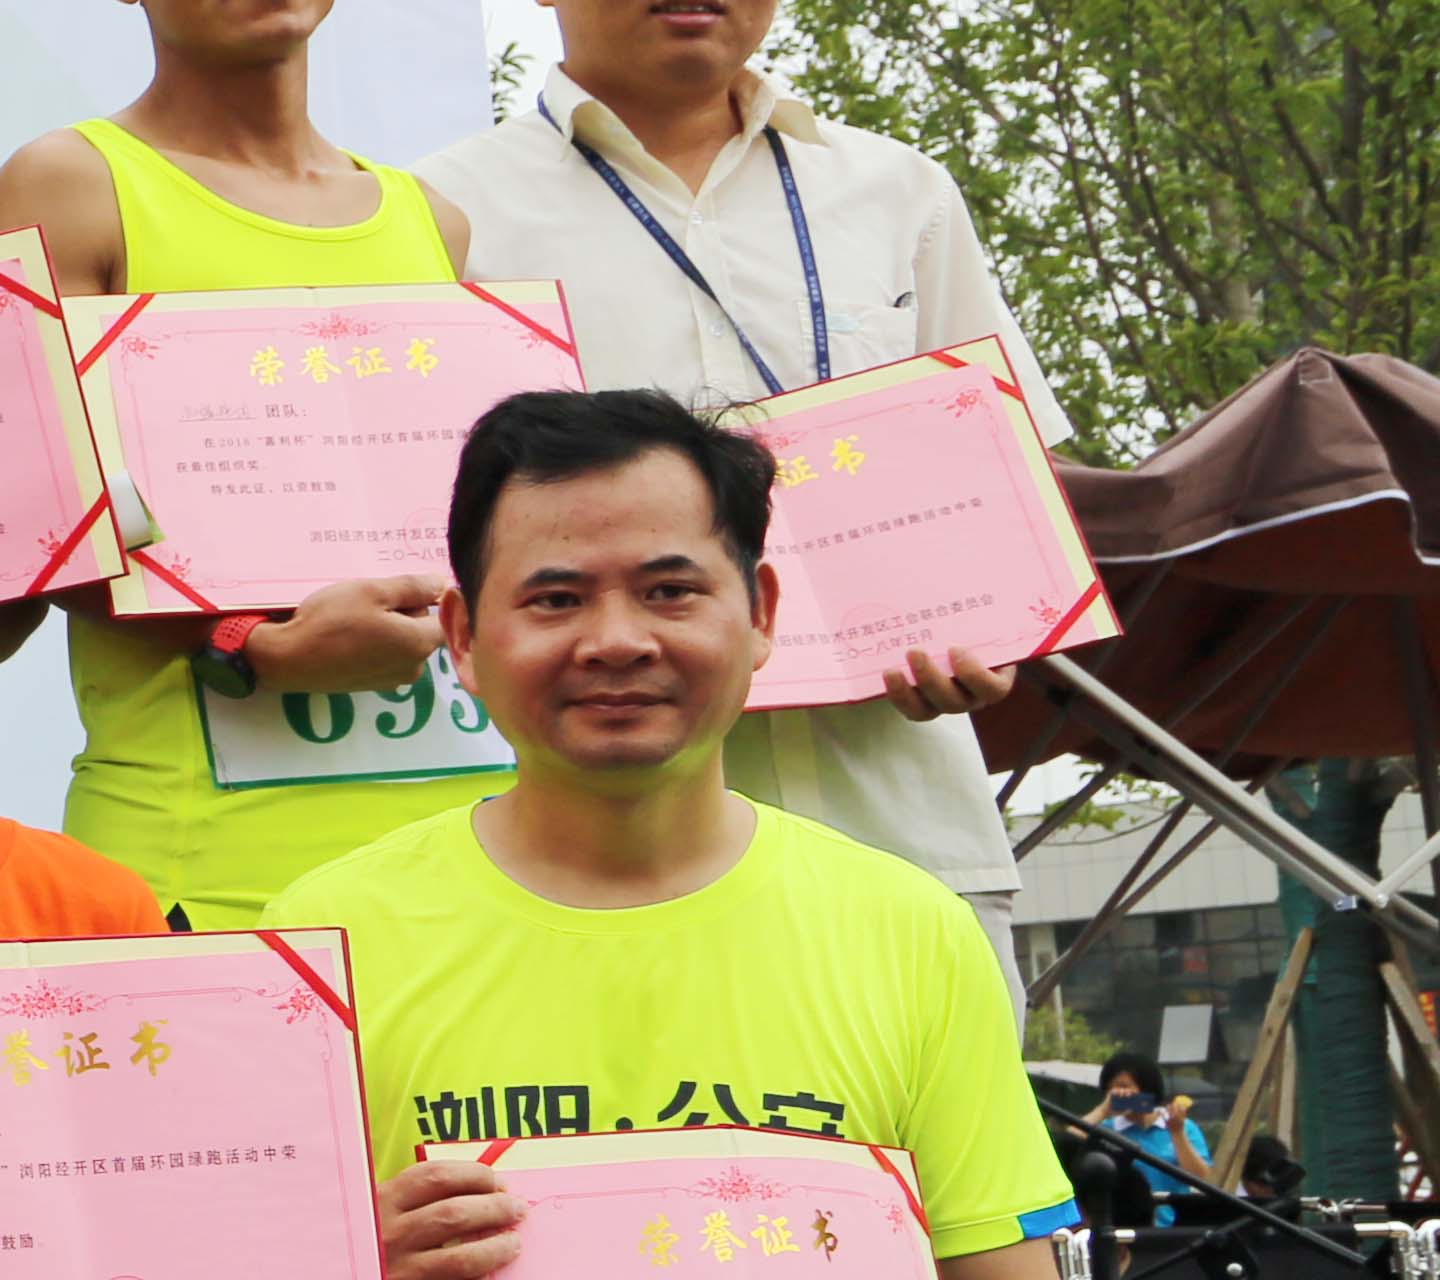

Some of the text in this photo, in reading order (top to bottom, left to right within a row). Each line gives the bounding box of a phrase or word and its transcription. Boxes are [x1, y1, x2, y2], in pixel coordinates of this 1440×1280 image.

[249, 337, 440, 386] 荣誉证书
[775, 434, 867, 489] 证书
[637, 1208, 839, 1269] 荣誉证书
